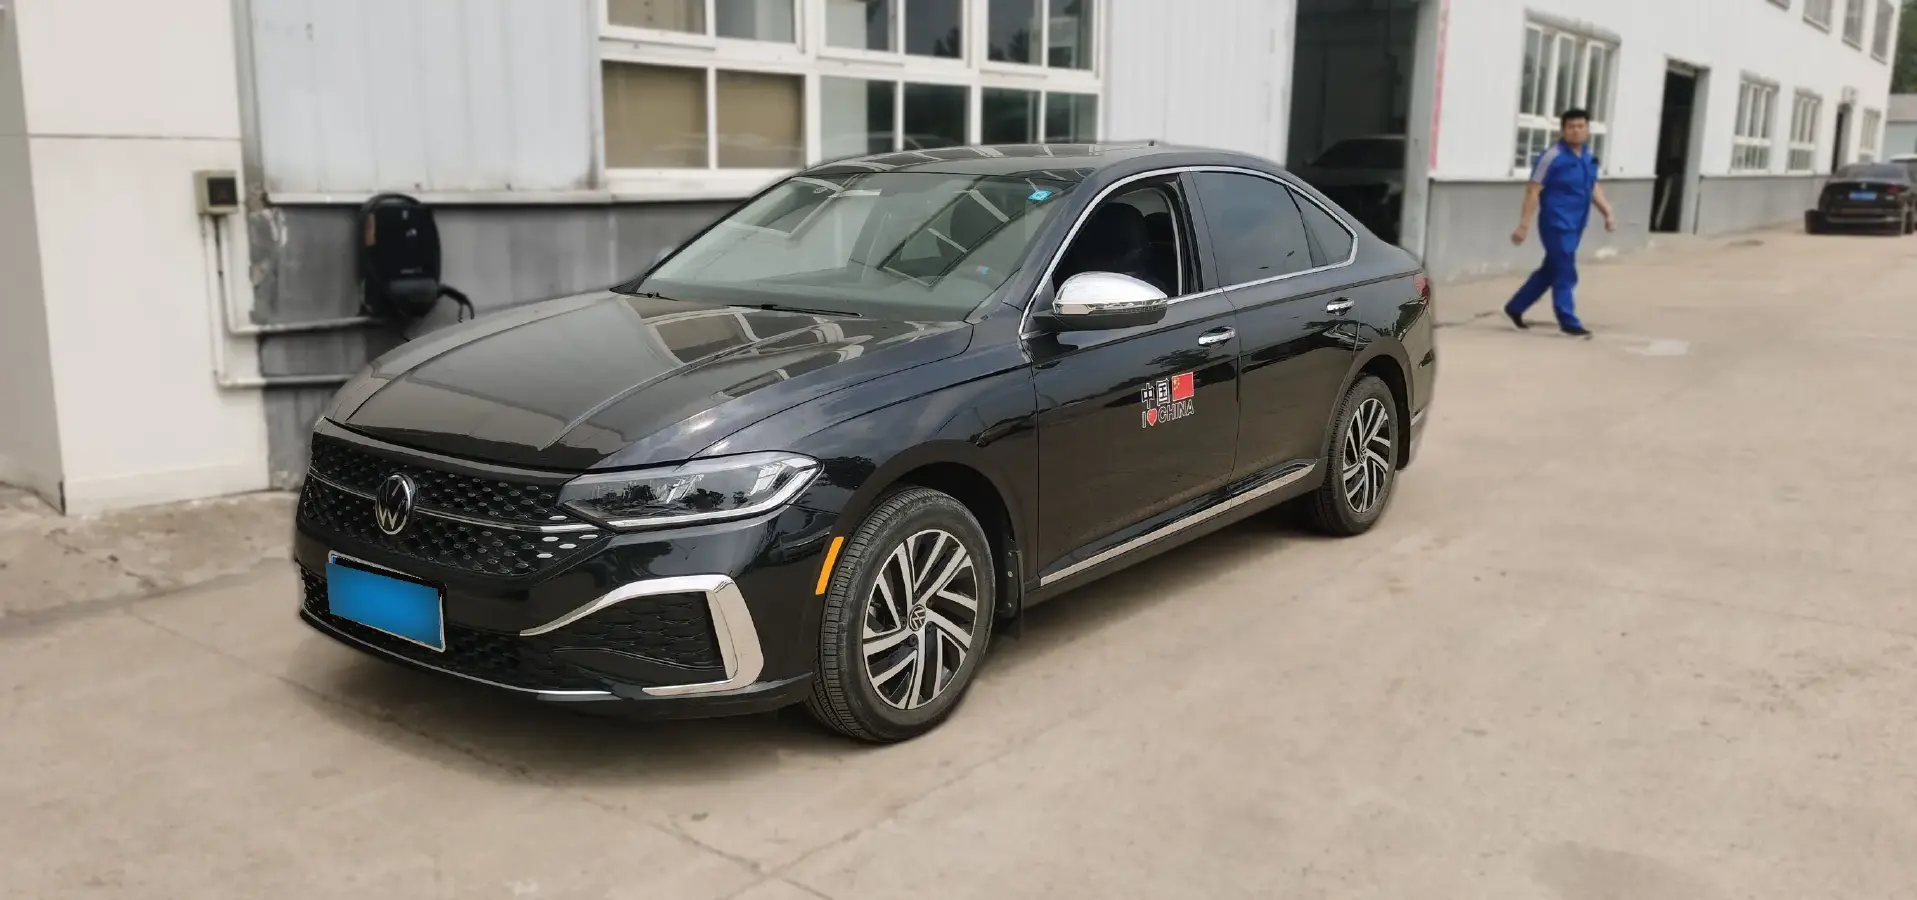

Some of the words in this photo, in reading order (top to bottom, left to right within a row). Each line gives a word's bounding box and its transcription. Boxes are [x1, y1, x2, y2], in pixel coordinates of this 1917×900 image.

[1141, 378, 1170, 409] 中国
[1142, 411, 1147, 428] I
[1158, 399, 1194, 423] CHINA
[377, 475, 409, 533] VW
